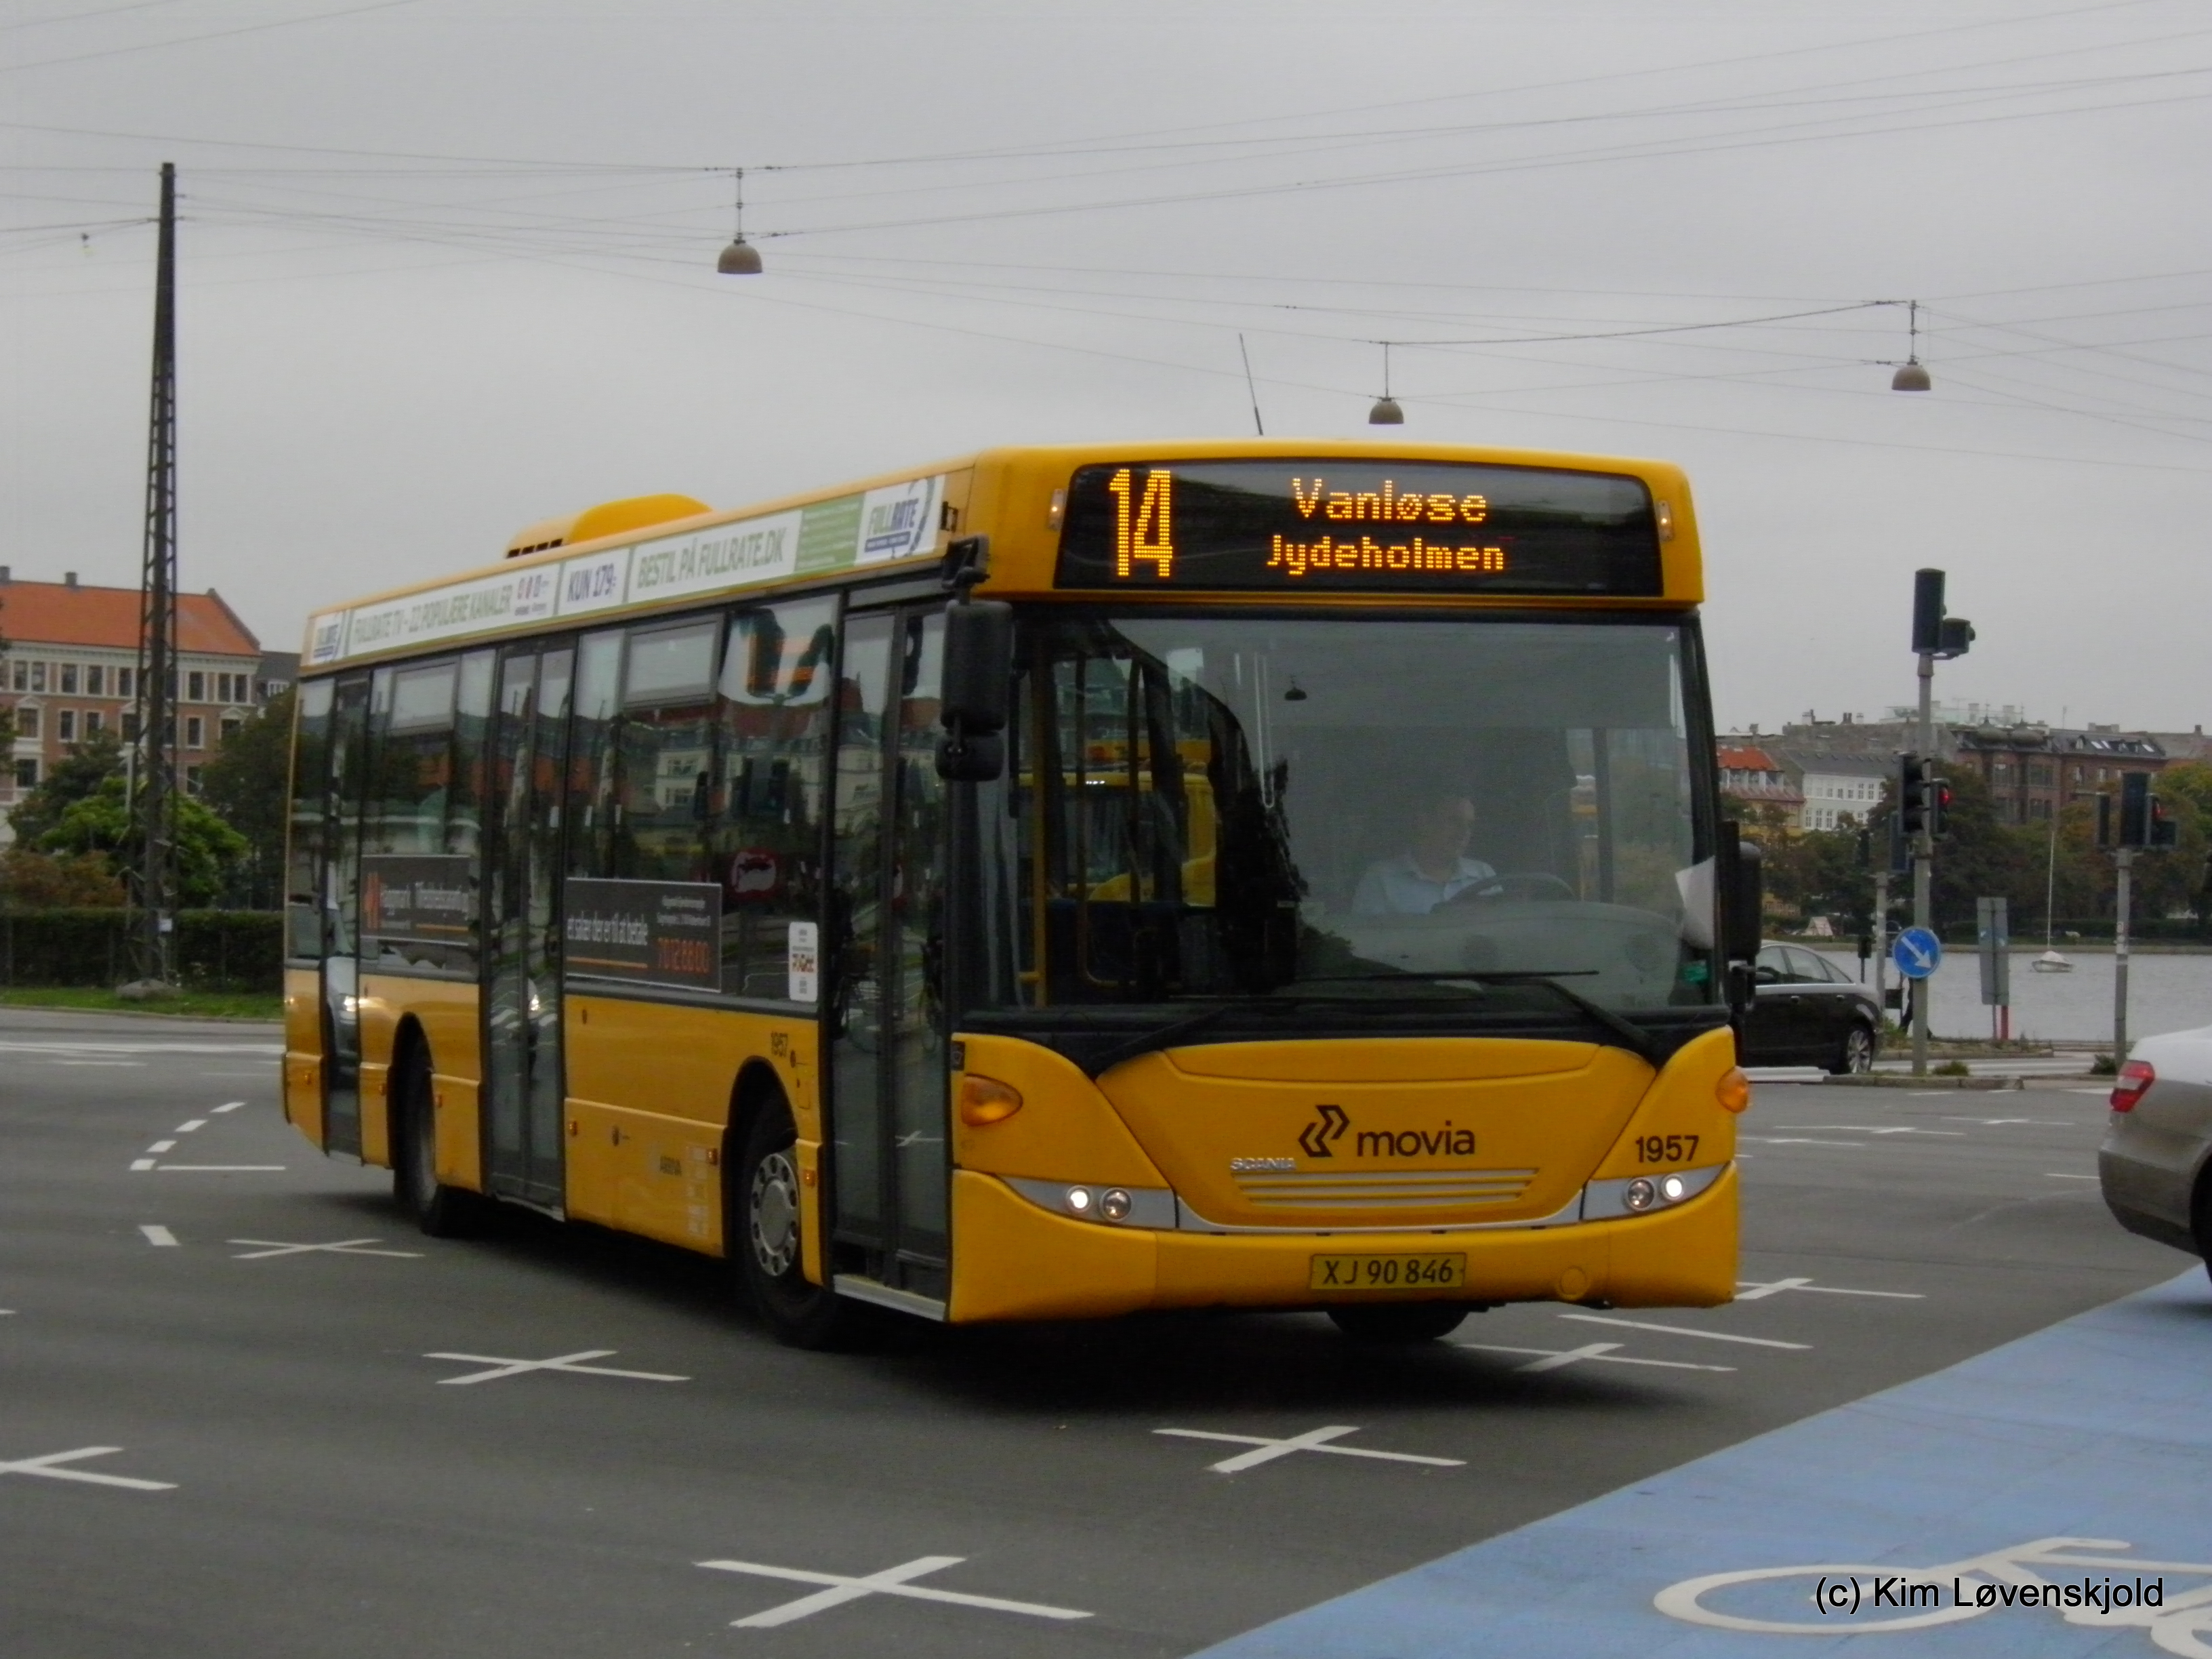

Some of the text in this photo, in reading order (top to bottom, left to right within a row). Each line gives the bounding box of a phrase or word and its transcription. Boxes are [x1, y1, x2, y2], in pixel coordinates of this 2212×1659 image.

[1292, 478, 1487, 521] Vanløse
[1109, 468, 1173, 577] 14
[637, 527, 787, 588] BESTIL PÅ FULLRATE.DK
[1267, 535, 1504, 575] Jydeholmen
[567, 569, 592, 602] KUN
[1357, 1120, 1475, 1157] movia
[1636, 1135, 1699, 1163] 1957
[1230, 1158, 1297, 1171] SCANIA
[1324, 1258, 1453, 1285] XJ 90 846
